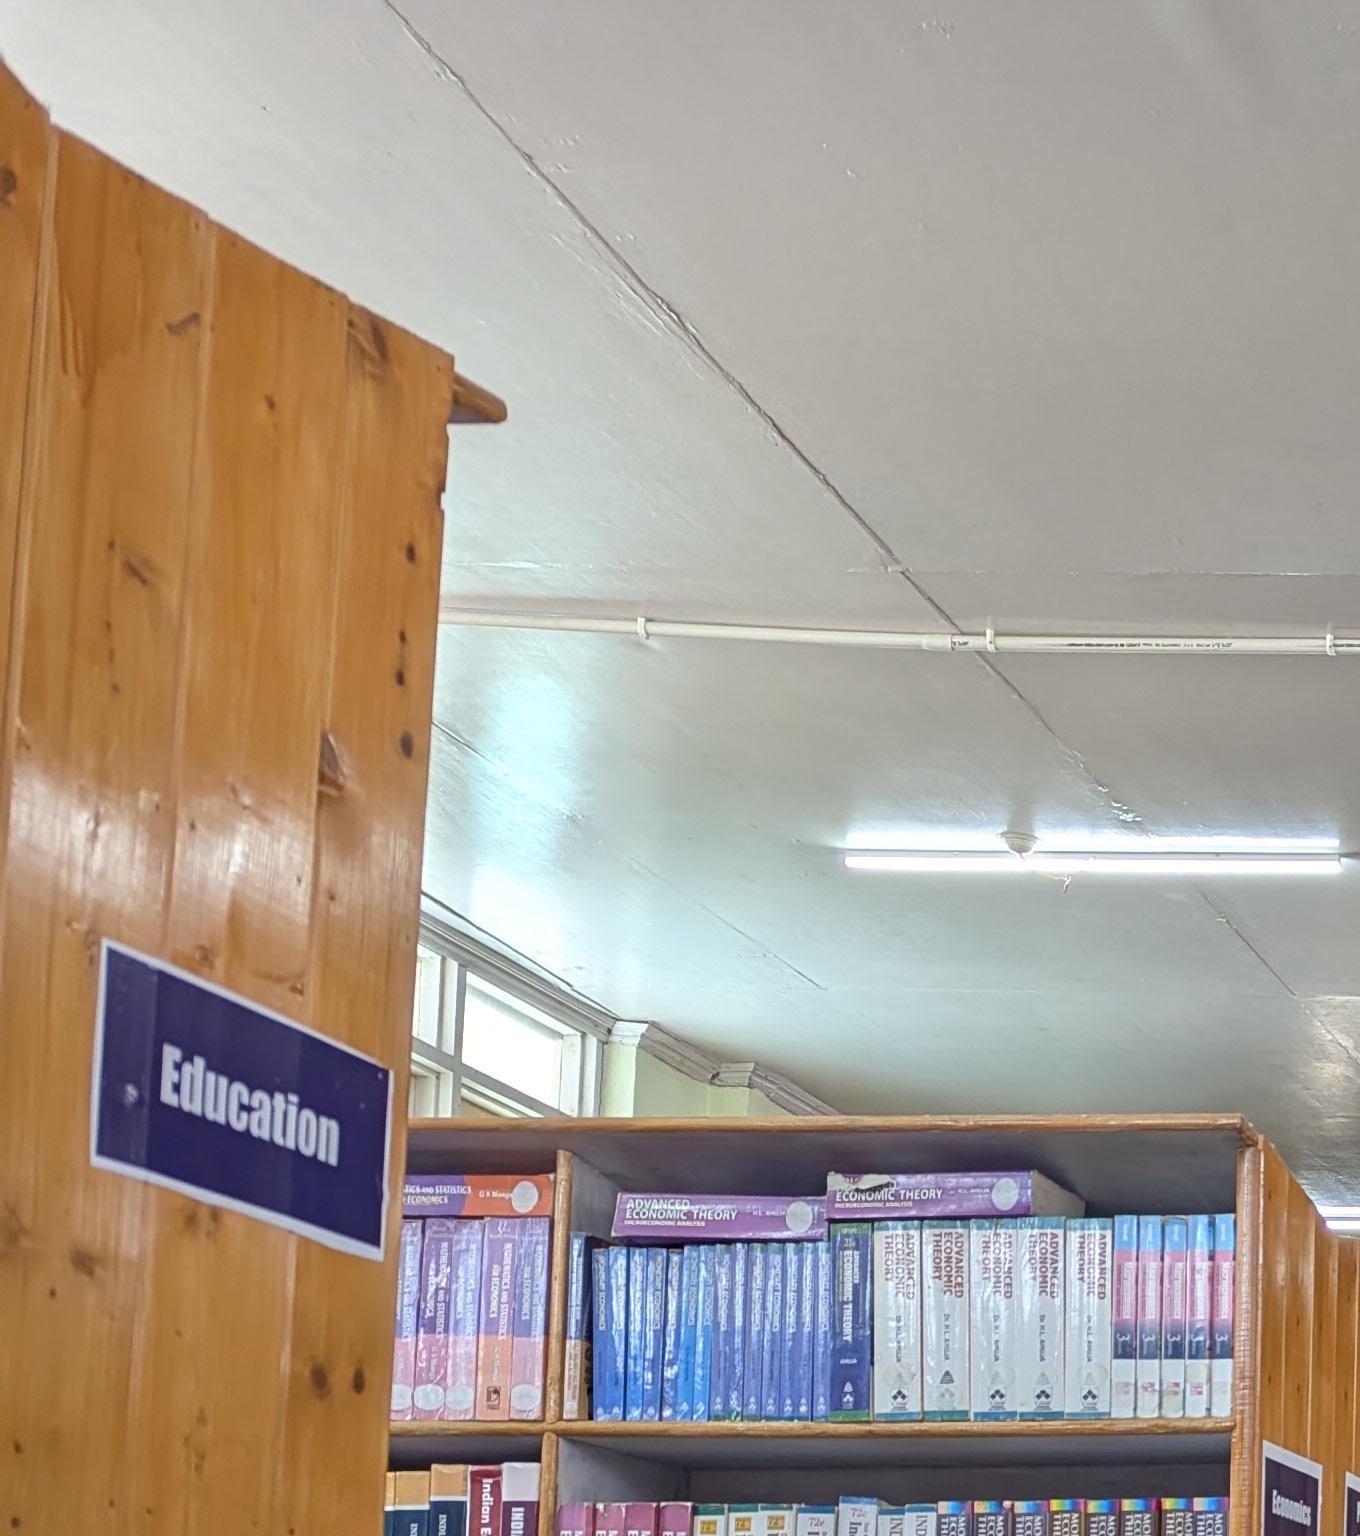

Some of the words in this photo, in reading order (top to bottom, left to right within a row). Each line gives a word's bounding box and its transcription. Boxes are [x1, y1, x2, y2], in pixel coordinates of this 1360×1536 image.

[160, 1042, 340, 1168] Education
[626, 1209, 688, 1220] ECONOMIC
[693, 1209, 738, 1221] THEORY
[627, 1199, 690, 1210] ADVANCED
[836, 1191, 895, 1201] ECONOMIC
[899, 1189, 943, 1200] THEORY
[884, 1235, 894, 1282] THEORY
[895, 1235, 904, 1298] ECONOMIC
[905, 1235, 915, 1300] ADVANCED
[933, 1232, 942, 1281] THEORY
[943, 1232, 953, 1296] ECONOMIC
[954, 1232, 964, 1299] ADVANCED
[481, 1478, 493, 1524] Indian
[1272, 1489, 1311, 1526] Economics
